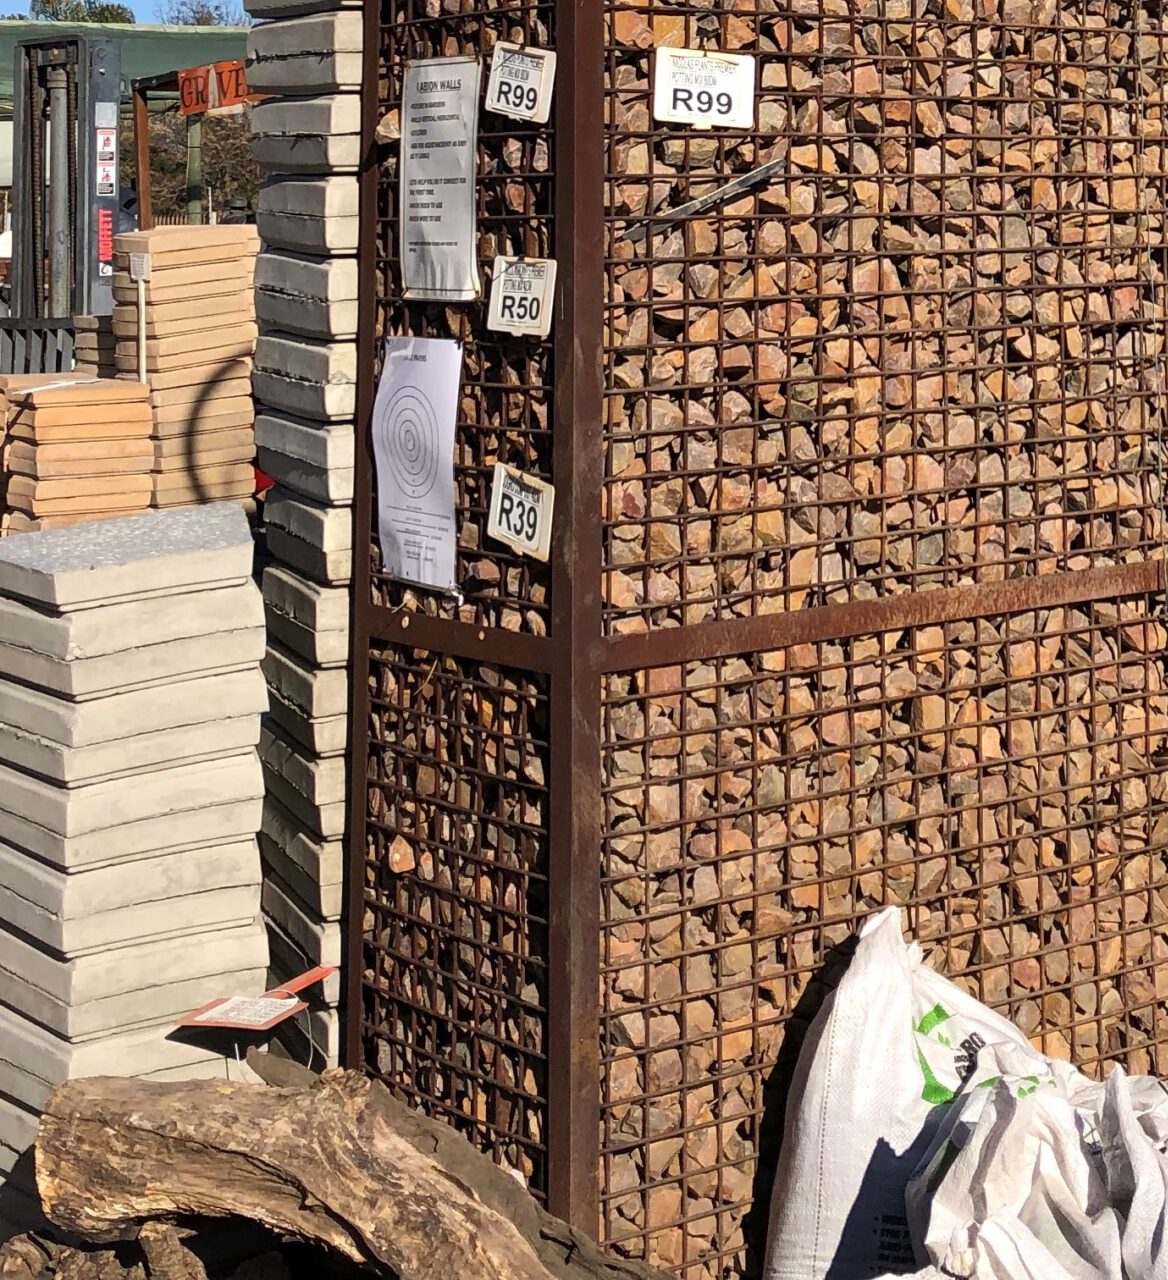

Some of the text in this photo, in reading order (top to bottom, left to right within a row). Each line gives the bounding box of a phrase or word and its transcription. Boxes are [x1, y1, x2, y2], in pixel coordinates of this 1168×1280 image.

[181, 67, 246, 108] GRVE
[440, 78, 462, 91] WALLS
[496, 80, 538, 111] R99
[672, 87, 733, 115] R99
[501, 295, 540, 320] R50
[498, 491, 538, 542] R39
